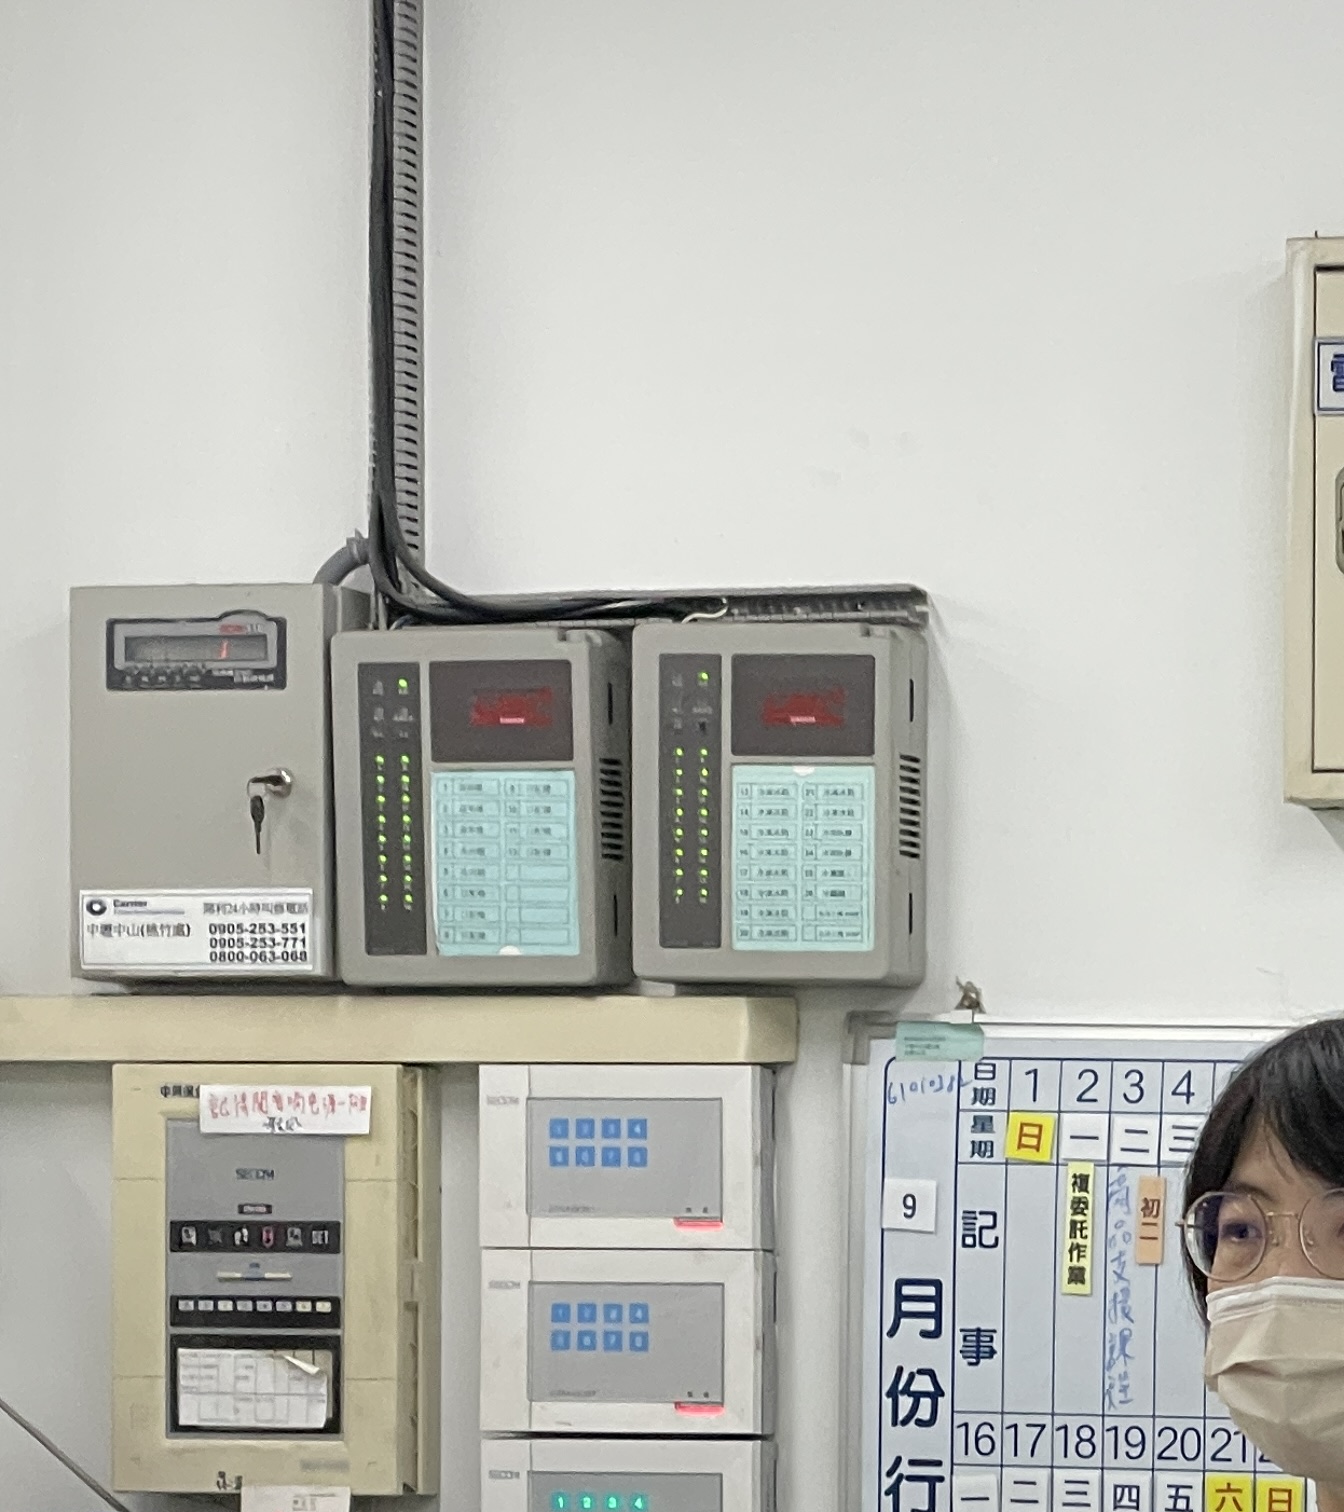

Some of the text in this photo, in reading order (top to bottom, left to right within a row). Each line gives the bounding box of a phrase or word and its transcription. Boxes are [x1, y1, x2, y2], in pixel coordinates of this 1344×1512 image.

[972, 1062, 997, 1106] 日期
[1024, 1069, 1039, 1102] 1
[1076, 1071, 1099, 1103] 2
[1122, 1069, 1145, 1104] 3
[1170, 1070, 1195, 1104] 4
[970, 1115, 996, 1159] 星期
[1016, 1122, 1044, 1153] 日
[1119, 1127, 1151, 1154] 二
[1168, 1123, 1198, 1154] 三
[901, 1193, 918, 1220] 9
[1139, 1197, 1162, 1242] 初二
[956, 1421, 996, 1457] 16
[1004, 1423, 1046, 1458] 17
[1055, 1423, 1096, 1459] 18
[1105, 1424, 1147, 1460] 19
[1156, 1426, 1201, 1462] 20
[1210, 1427, 1246, 1463] 21
[634, 1497, 643, 1510] 4
[1009, 1479, 1039, 1507] 二
[1062, 1479, 1091, 1508] 三
[1112, 1484, 1141, 1512] 四
[1214, 1482, 1243, 1512] 六
